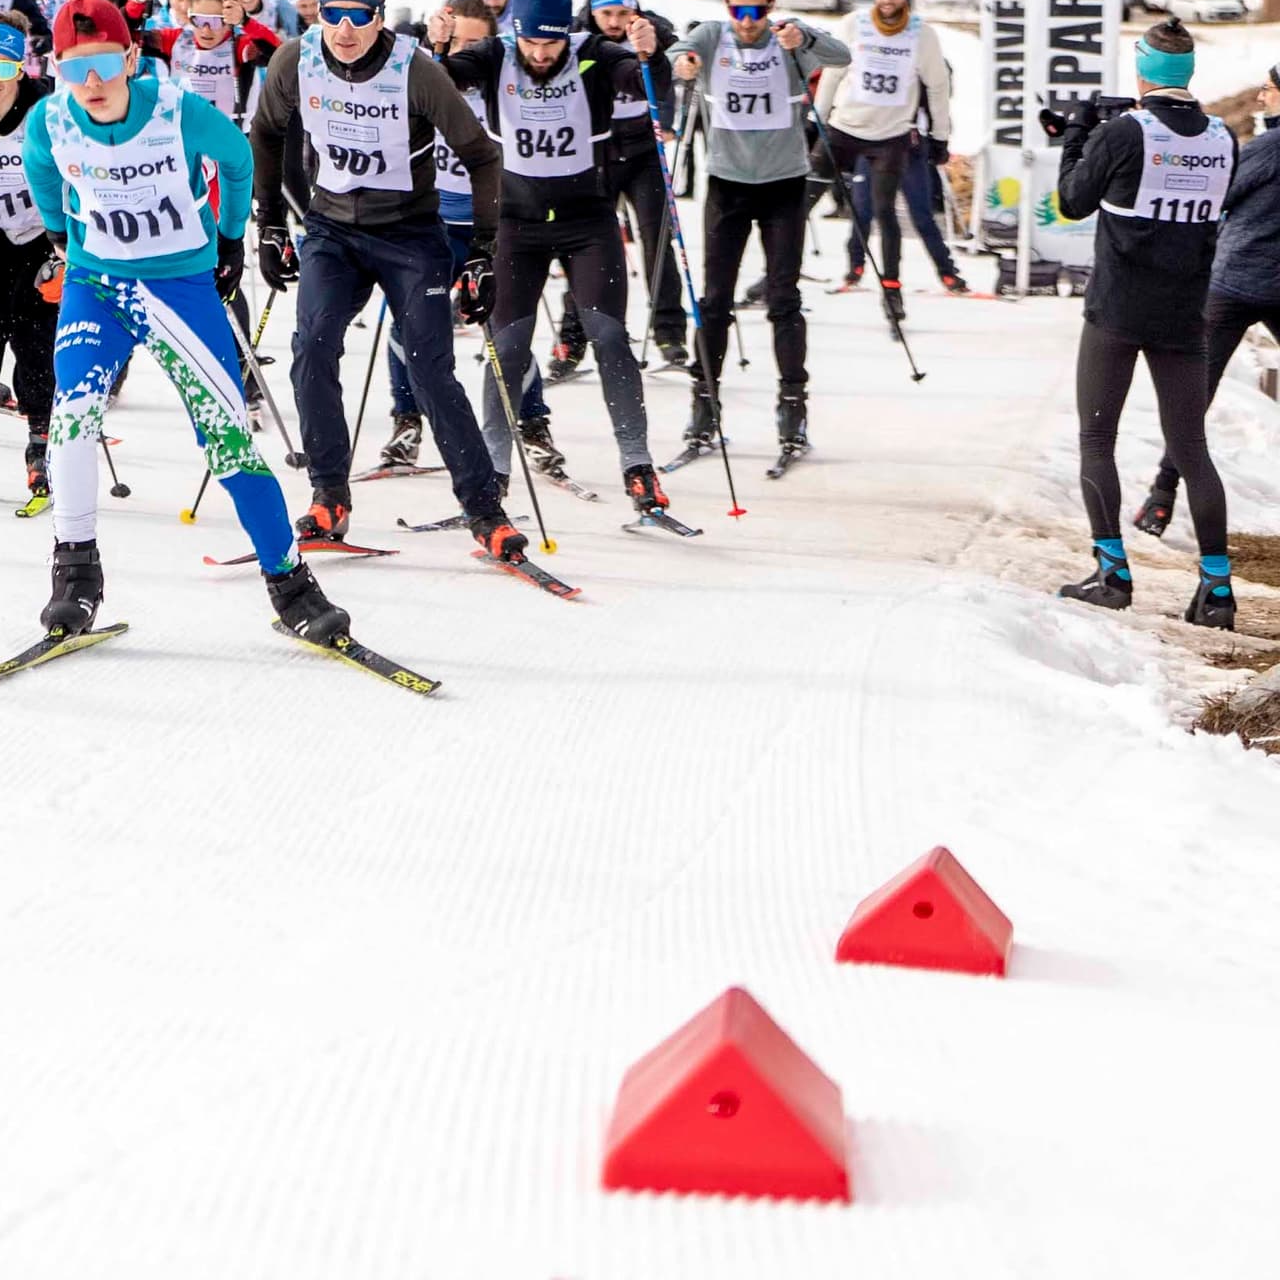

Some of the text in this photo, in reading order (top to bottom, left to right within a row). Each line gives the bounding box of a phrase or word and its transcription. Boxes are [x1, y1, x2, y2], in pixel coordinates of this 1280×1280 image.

[506, 80, 577, 102] ekosport
[726, 92, 771, 114] 871
[308, 95, 399, 120] ekosport
[515, 126, 576, 158] 842
[68, 155, 177, 185] ekosport
[327, 143, 387, 176] 901
[1152, 152, 1225, 171] ekosport
[90, 196, 183, 244] 1011
